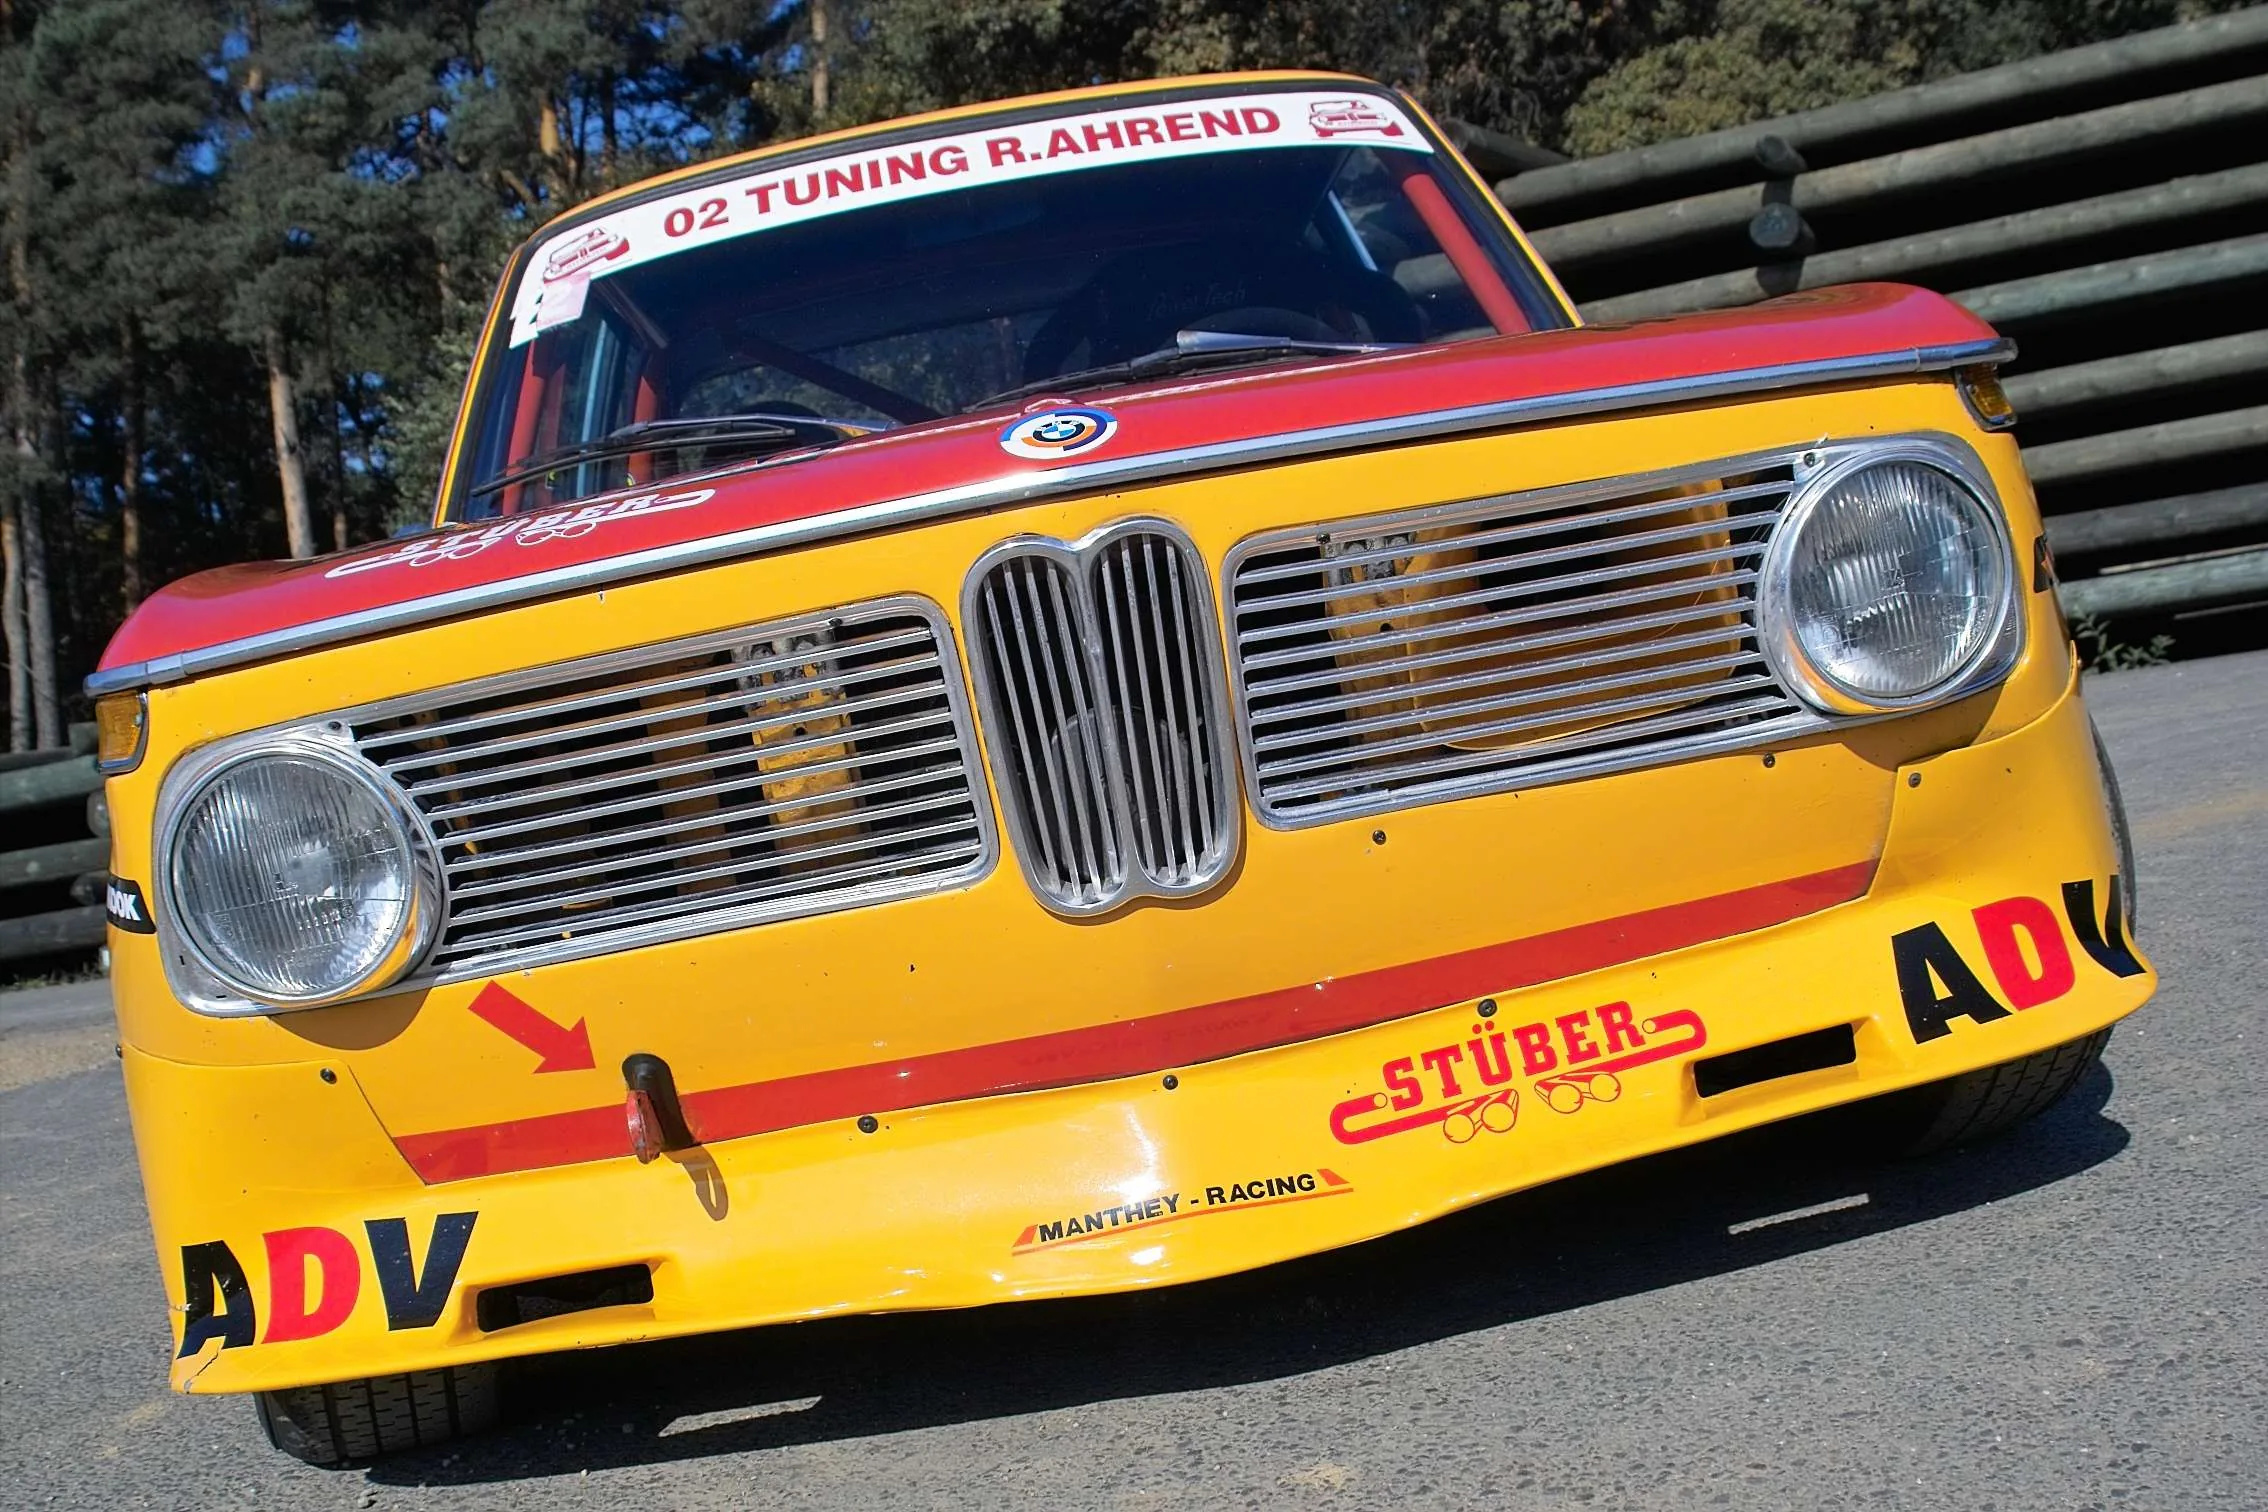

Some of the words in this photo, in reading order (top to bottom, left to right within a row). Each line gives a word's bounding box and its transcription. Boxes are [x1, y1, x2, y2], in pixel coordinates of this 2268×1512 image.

[664, 197, 729, 238] 02
[745, 146, 970, 215] TUNING
[985, 107, 1281, 168] R.AHREND
[1891, 874, 2147, 1045] ADV
[1382, 1000, 1646, 1112] STÜBER
[1038, 1193, 1180, 1244] MANTHEY
[1205, 1172, 1317, 1207] RACING
[176, 1210, 479, 1360] ADV
